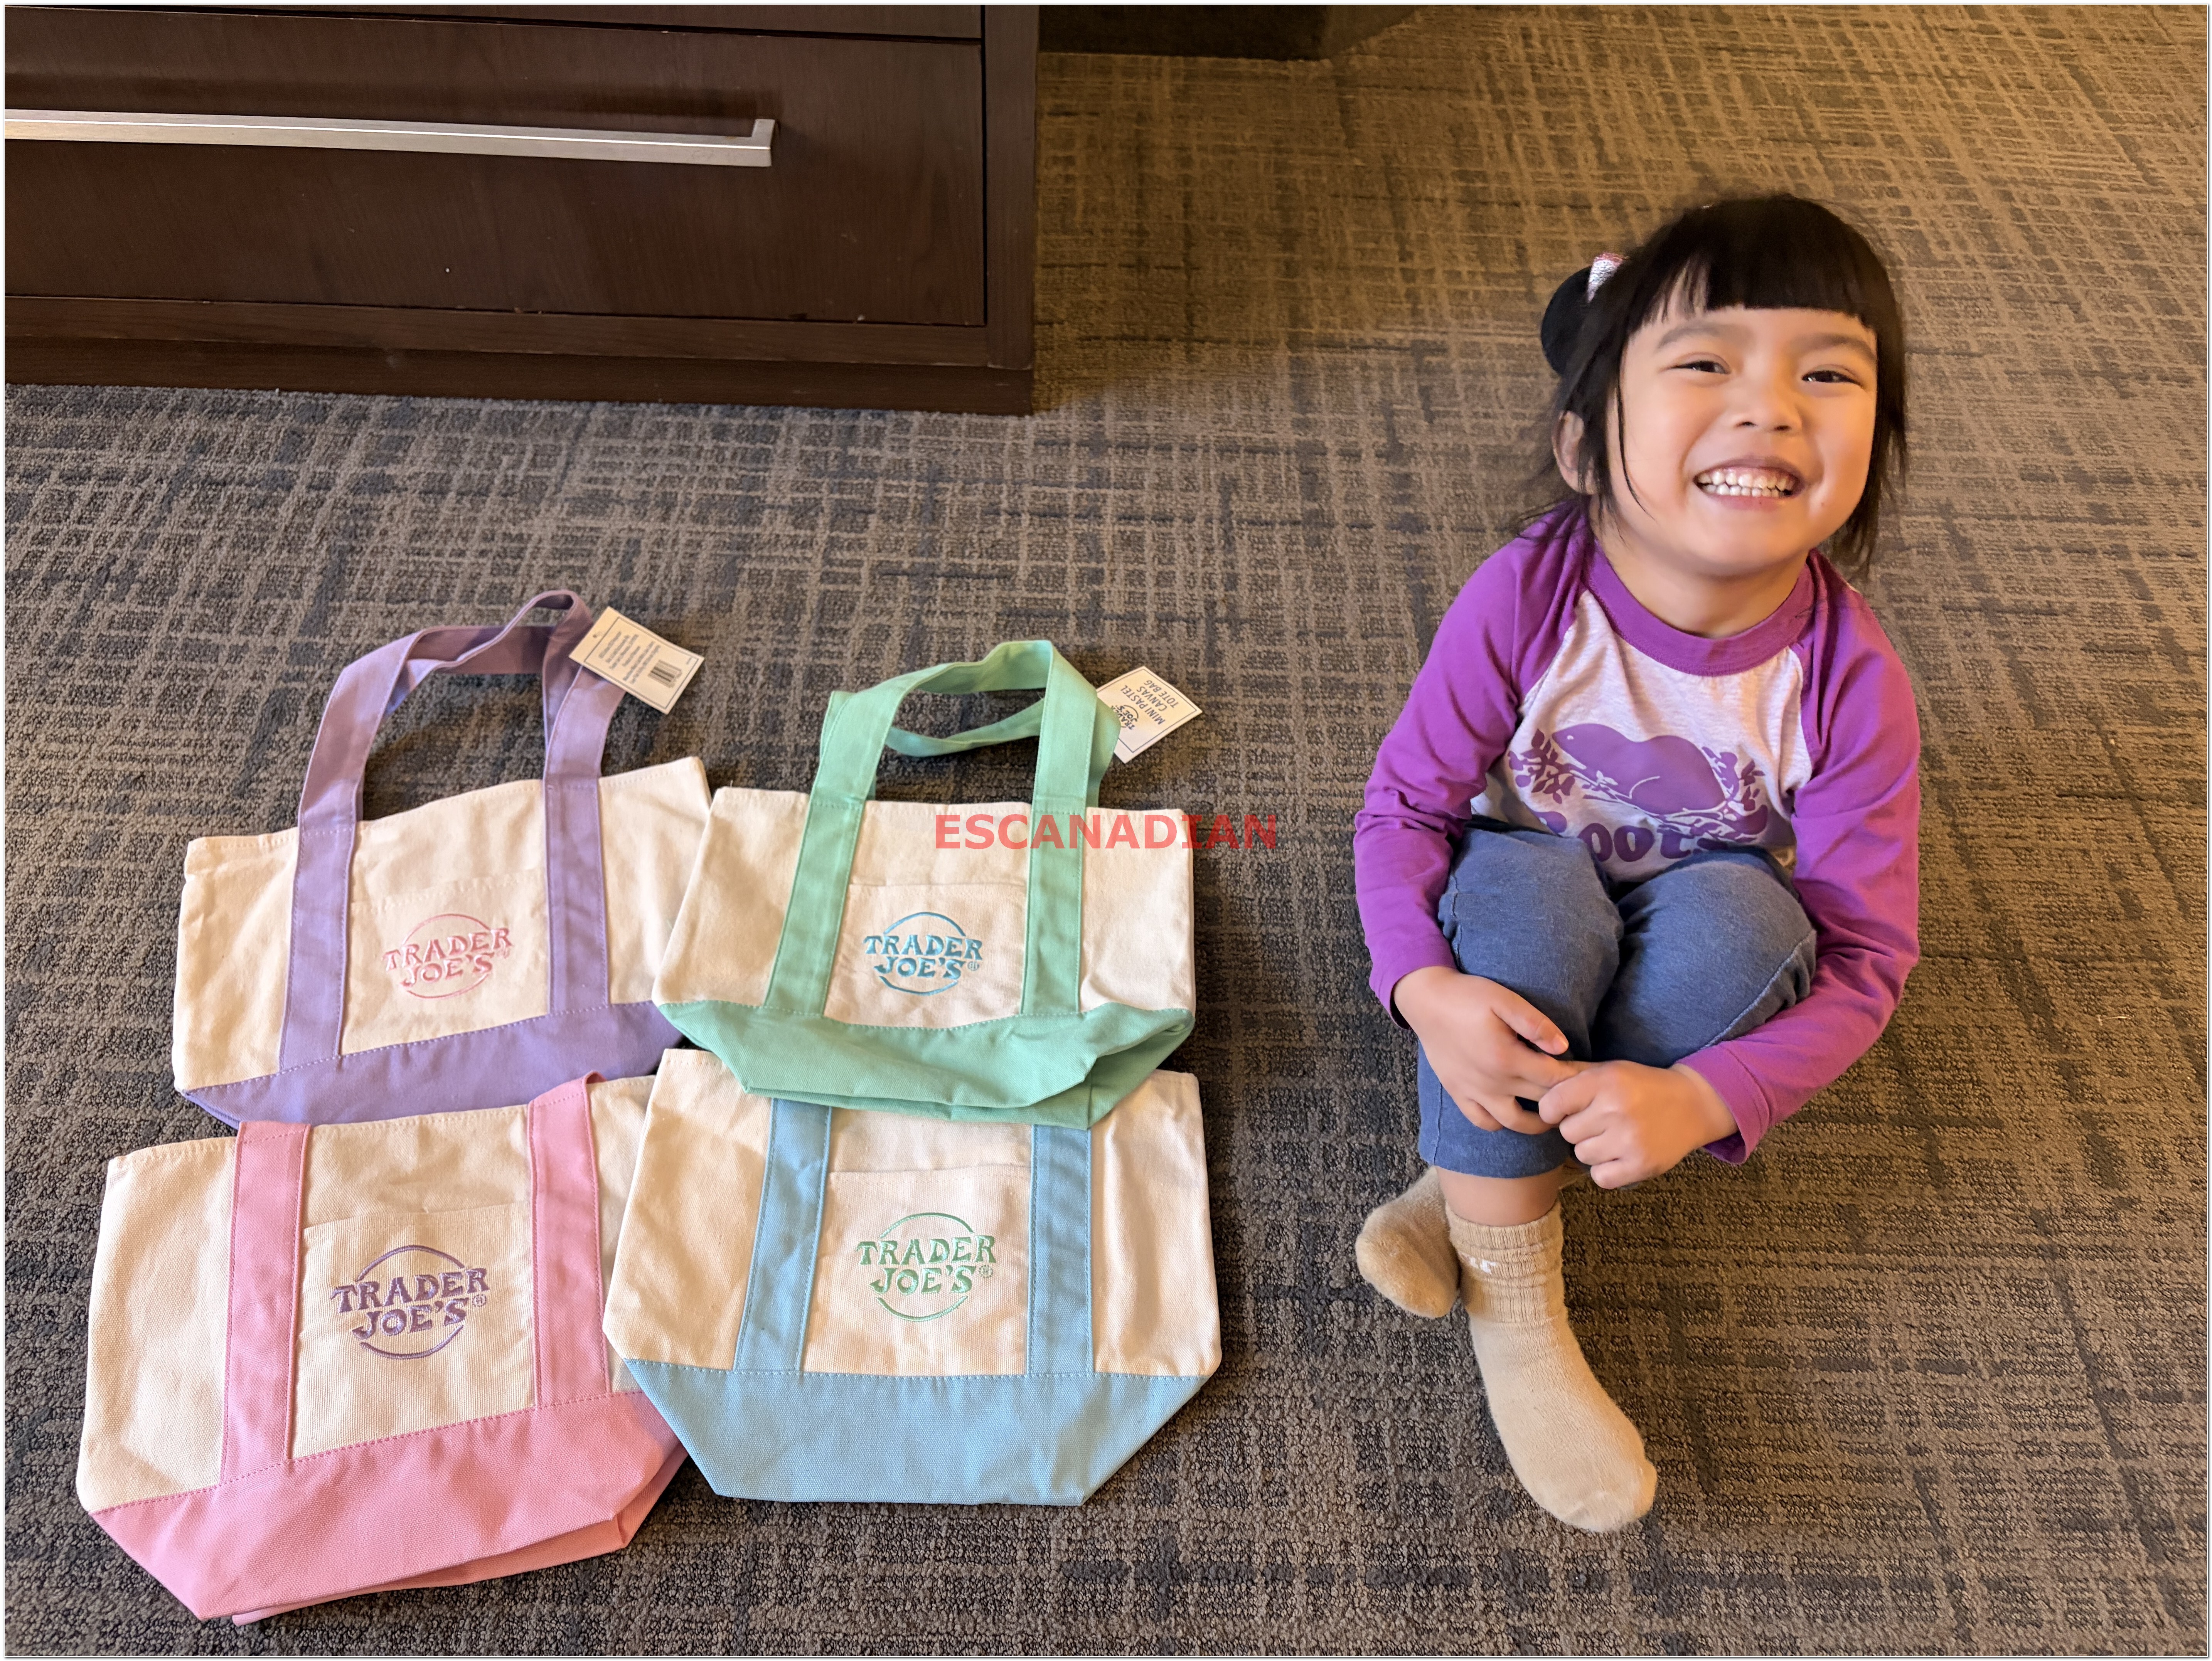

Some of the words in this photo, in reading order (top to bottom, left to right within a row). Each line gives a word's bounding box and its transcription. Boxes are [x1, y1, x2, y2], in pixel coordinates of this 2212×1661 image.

[1120, 685, 1148, 709] PASTEL
[1136, 686, 1167, 711] CANVAS
[1144, 680, 1162, 693] BAG
[1158, 691, 1179, 708] TOTE
[1118, 705, 1137, 722] JOE'S
[1144, 707, 1165, 725] MINI
[382, 927, 513, 971] TRADER
[863, 934, 983, 961] TRADER
[400, 952, 494, 987] JOE'S
[873, 956, 966, 980] JOE'S
[854, 1235, 997, 1265] TRADER
[330, 1268, 490, 1313] TRADER
[869, 1265, 976, 1295] JOE'S
[352, 1297, 469, 1340] JOE'S
